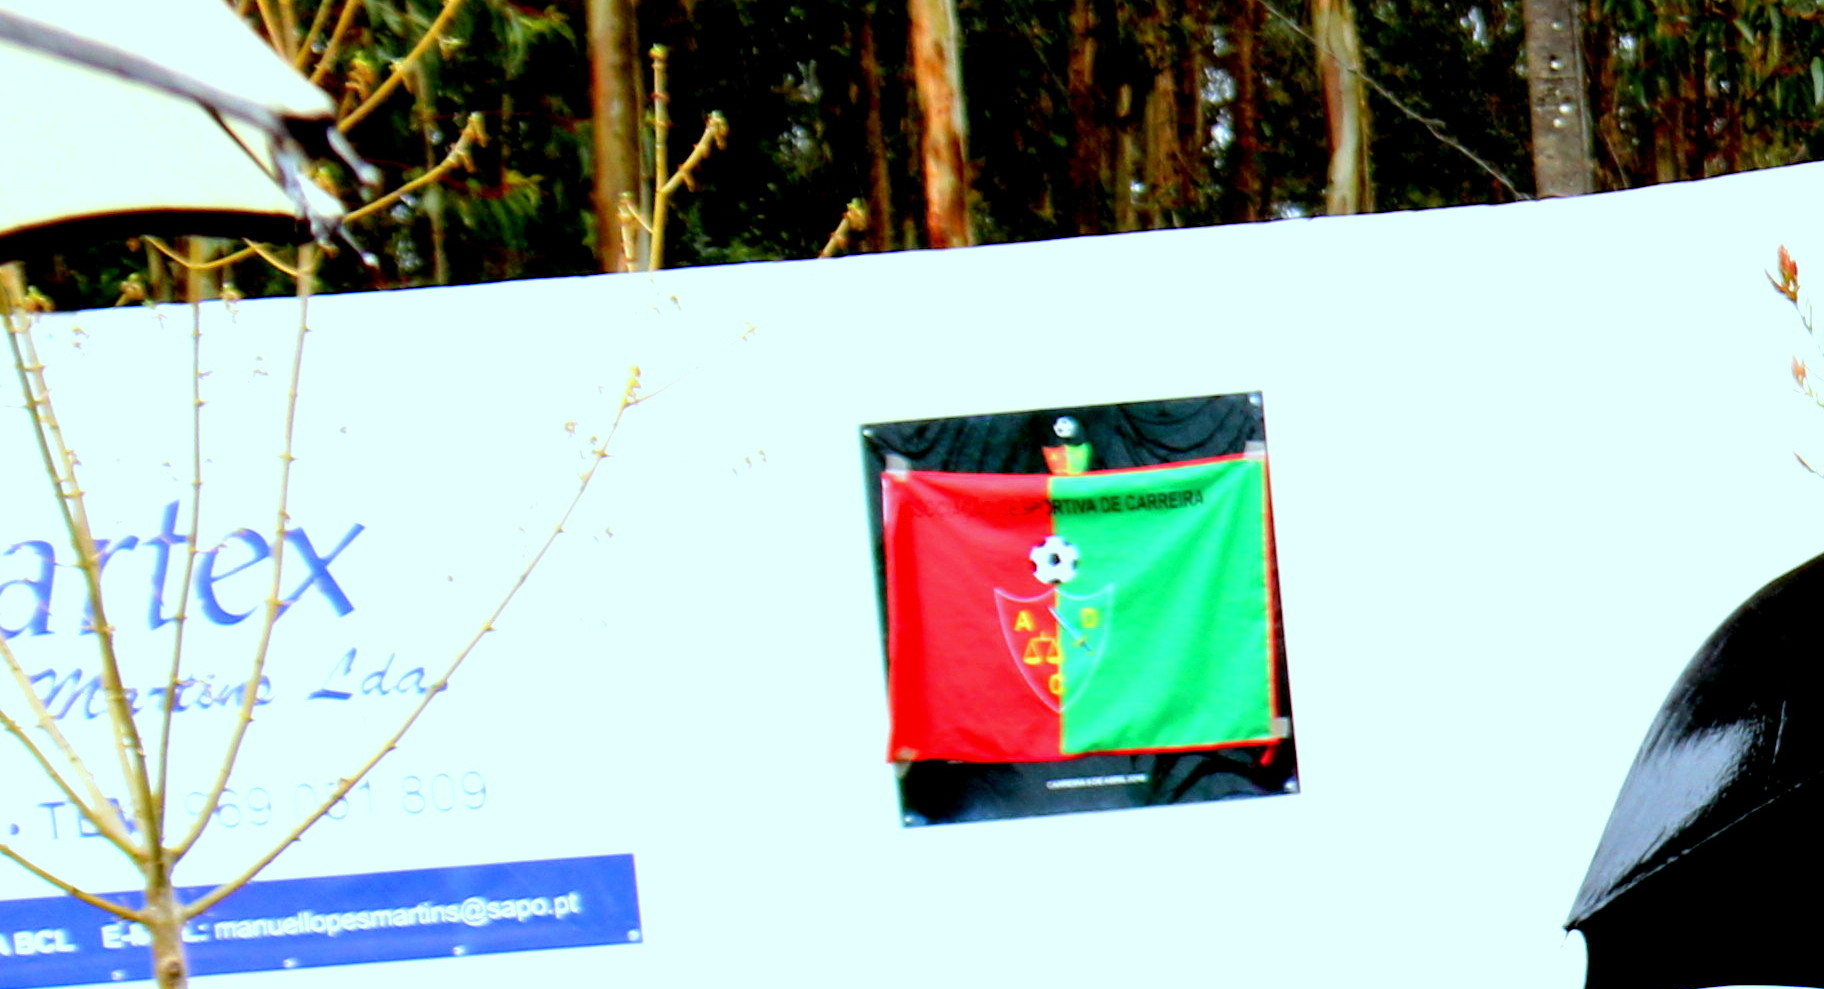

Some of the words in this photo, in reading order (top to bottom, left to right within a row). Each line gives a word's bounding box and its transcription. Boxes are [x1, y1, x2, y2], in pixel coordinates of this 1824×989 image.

[1100, 495, 1122, 514] DE
[1126, 489, 1205, 511] CARREIRA
[1013, 609, 1035, 631] A
[1080, 607, 1100, 629] D
[399, 771, 487, 814] 809
[13, 928, 77, 955] BCL
[213, 891, 581, 939] manuellopesmartins@sapo.pt
